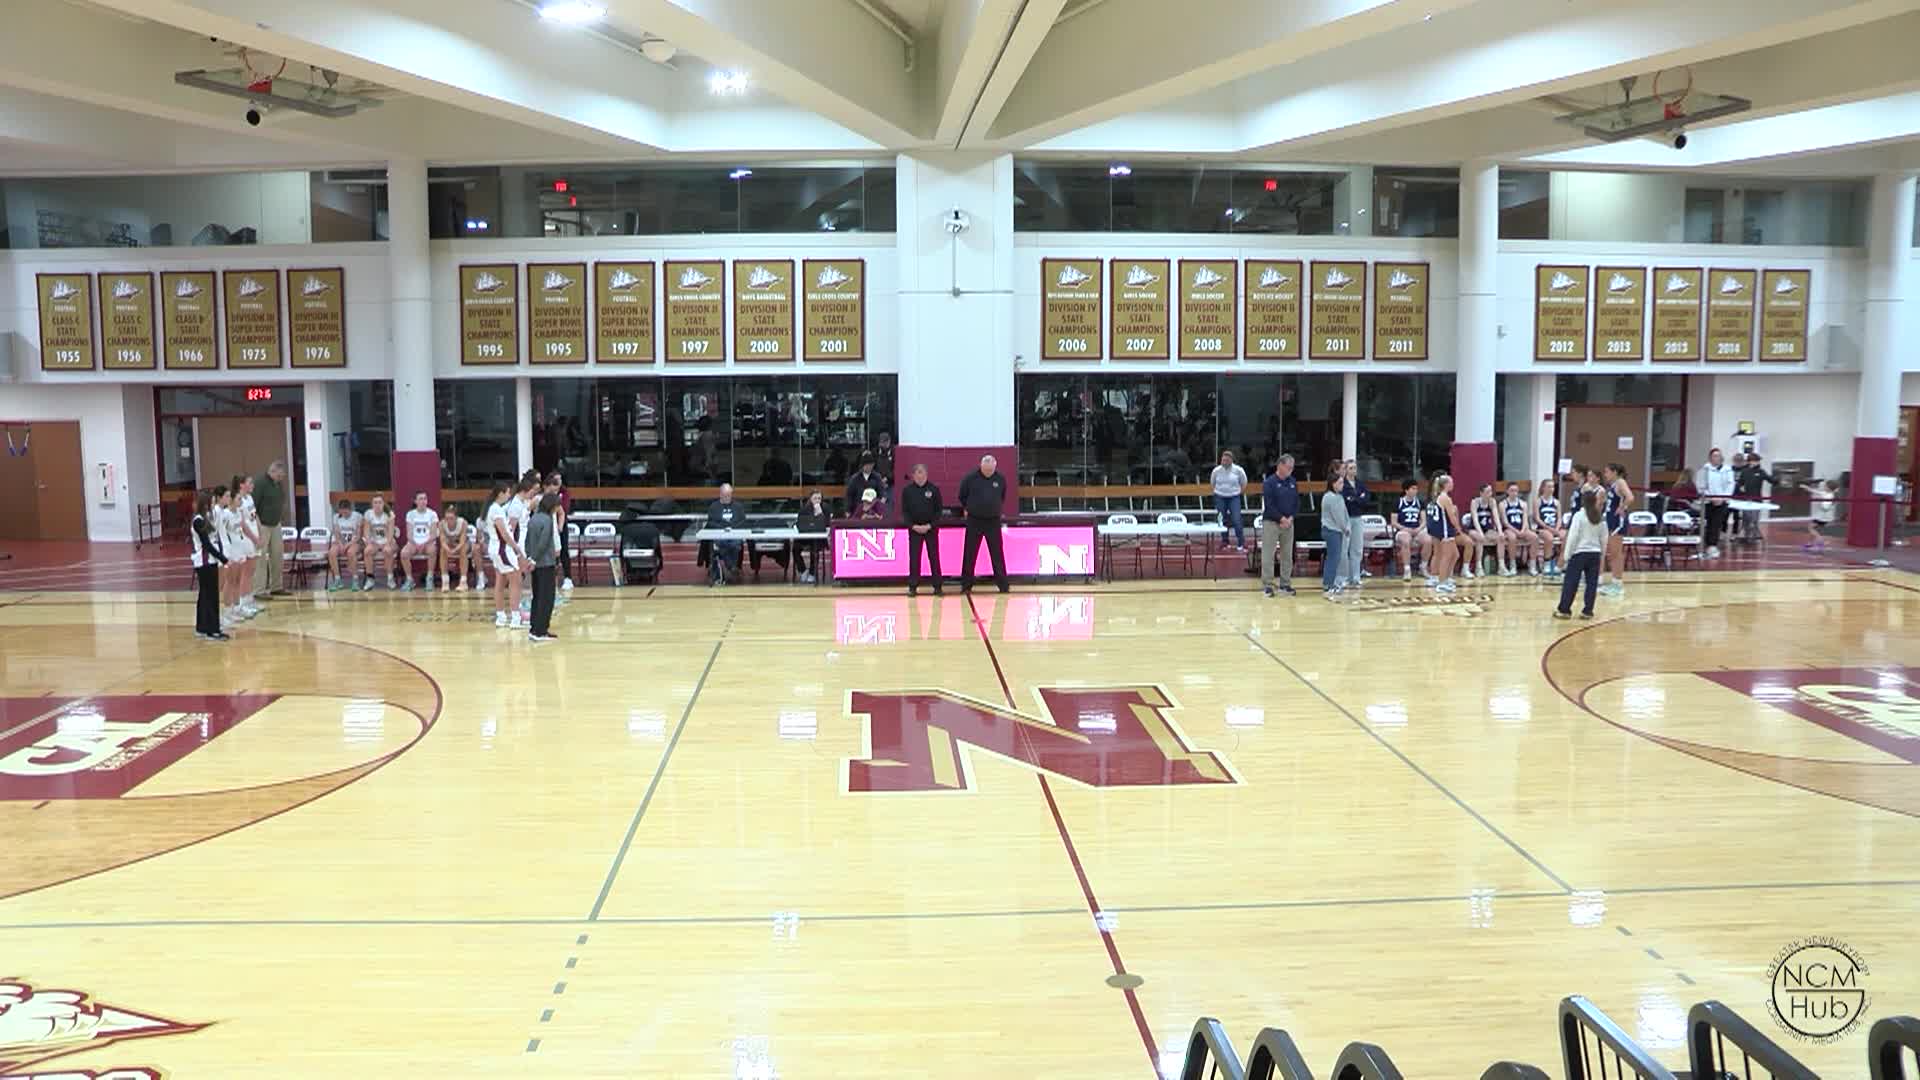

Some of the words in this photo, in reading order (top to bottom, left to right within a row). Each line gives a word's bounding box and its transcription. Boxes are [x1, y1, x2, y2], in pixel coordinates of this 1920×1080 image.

[535, 307, 570, 316] DIVISION
[573, 307, 581, 316] IV
[601, 307, 638, 315] DIVISION
[641, 307, 649, 315] IV
[673, 305, 709, 313] DIVISION
[711, 305, 718, 313] II
[740, 304, 777, 313] DIVISION
[780, 304, 788, 313] III
[811, 304, 848, 312] DIVISION
[850, 304, 856, 312] II
[1049, 303, 1086, 312] DIVISION
[1088, 303, 1096, 312] IV
[1117, 303, 1154, 311] DIVISION
[1155, 303, 1164, 311] III
[1185, 303, 1221, 312] DIVISION
[1223, 303, 1231, 312] III
[1252, 303, 1287, 312] DIVISION
[1289, 303, 1295, 312] II
[1380, 305, 1413, 314] DIVISION
[1542, 307, 1574, 315] DIVISION
[232, 312, 264, 322] DIVISION
[295, 312, 328, 320] DIVISION
[468, 308, 503, 317] DIVISION
[52, 316, 74, 325] CLASS
[114, 315, 135, 324] CLASS
[137, 315, 142, 324] C
[176, 314, 198, 324] CLASS
[601, 318, 624, 326] SUPER
[628, 318, 649, 326] BOWL
[685, 317, 706, 325] STATE
[753, 315, 775, 324] STATE
[822, 315, 845, 324] STATE
[1062, 315, 1083, 323] STATE
[1130, 315, 1151, 323] STATE
[1198, 315, 1218, 323] STATE
[1263, 315, 1284, 323] STATE
[1328, 315, 1348, 323] STATE
[1392, 316, 1411, 325] STATE
[1553, 318, 1572, 326] STATE
[232, 324, 251, 333] SUPER
[254, 324, 274, 333] BOWL
[296, 323, 316, 331] SUPER
[318, 323, 338, 331] BOWL
[480, 320, 500, 328] STATE
[535, 320, 557, 328] SUPER
[560, 320, 581, 328] BOWL
[57, 327, 76, 336] STATE
[119, 326, 137, 335] STATE
[181, 326, 200, 334] STATE
[535, 329, 582, 338] CHAMPIONS
[602, 329, 649, 337] CHAMPIONS
[672, 328, 720, 336] CHAMPIONS
[740, 328, 789, 336] CHAMPIONS
[809, 327, 858, 336] CHAMPIONS
[1049, 325, 1097, 334] CHAMPIONS
[1116, 325, 1164, 334] CHAMPIONS
[1184, 325, 1232, 334] CHAMPIONS
[1251, 325, 1296, 334] CHAMPIONS
[1315, 326, 1360, 335] CHAMPIONS
[1379, 327, 1423, 336] CHAMPIONS
[296, 334, 340, 344] CHAMPIONS
[467, 330, 513, 339] CHAMPIONS
[46, 337, 88, 346] CHAMPIONS
[107, 337, 150, 346] CHAMPIONS
[169, 336, 212, 344] CHAMPIONS
[232, 335, 276, 344] CHAMPIONS
[546, 343, 571, 355] 1995
[612, 343, 638, 354] 1997
[682, 341, 709, 353] 1997
[750, 341, 778, 352] 2000
[821, 340, 847, 352] 2001
[1059, 339, 1086, 352] 2006
[1126, 339, 1154, 351] 2007
[1194, 339, 1222, 351] 2008
[1260, 339, 1287, 351] 2009
[1326, 339, 1349, 351] 2011
[1389, 340, 1413, 352] 2011
[1550, 341, 1574, 352] 2012
[1607, 341, 1631, 352] 2013
[1664, 342, 1688, 354] 2013
[306, 347, 330, 360] 1976
[478, 344, 503, 356] 1995
[56, 351, 80, 363] 1955
[118, 351, 141, 362] 1956
[179, 350, 203, 362] 1966
[242, 349, 266, 361] 1975
[842, 529, 895, 560] N
[1038, 545, 1088, 575] N
[839, 685, 1248, 798] N
